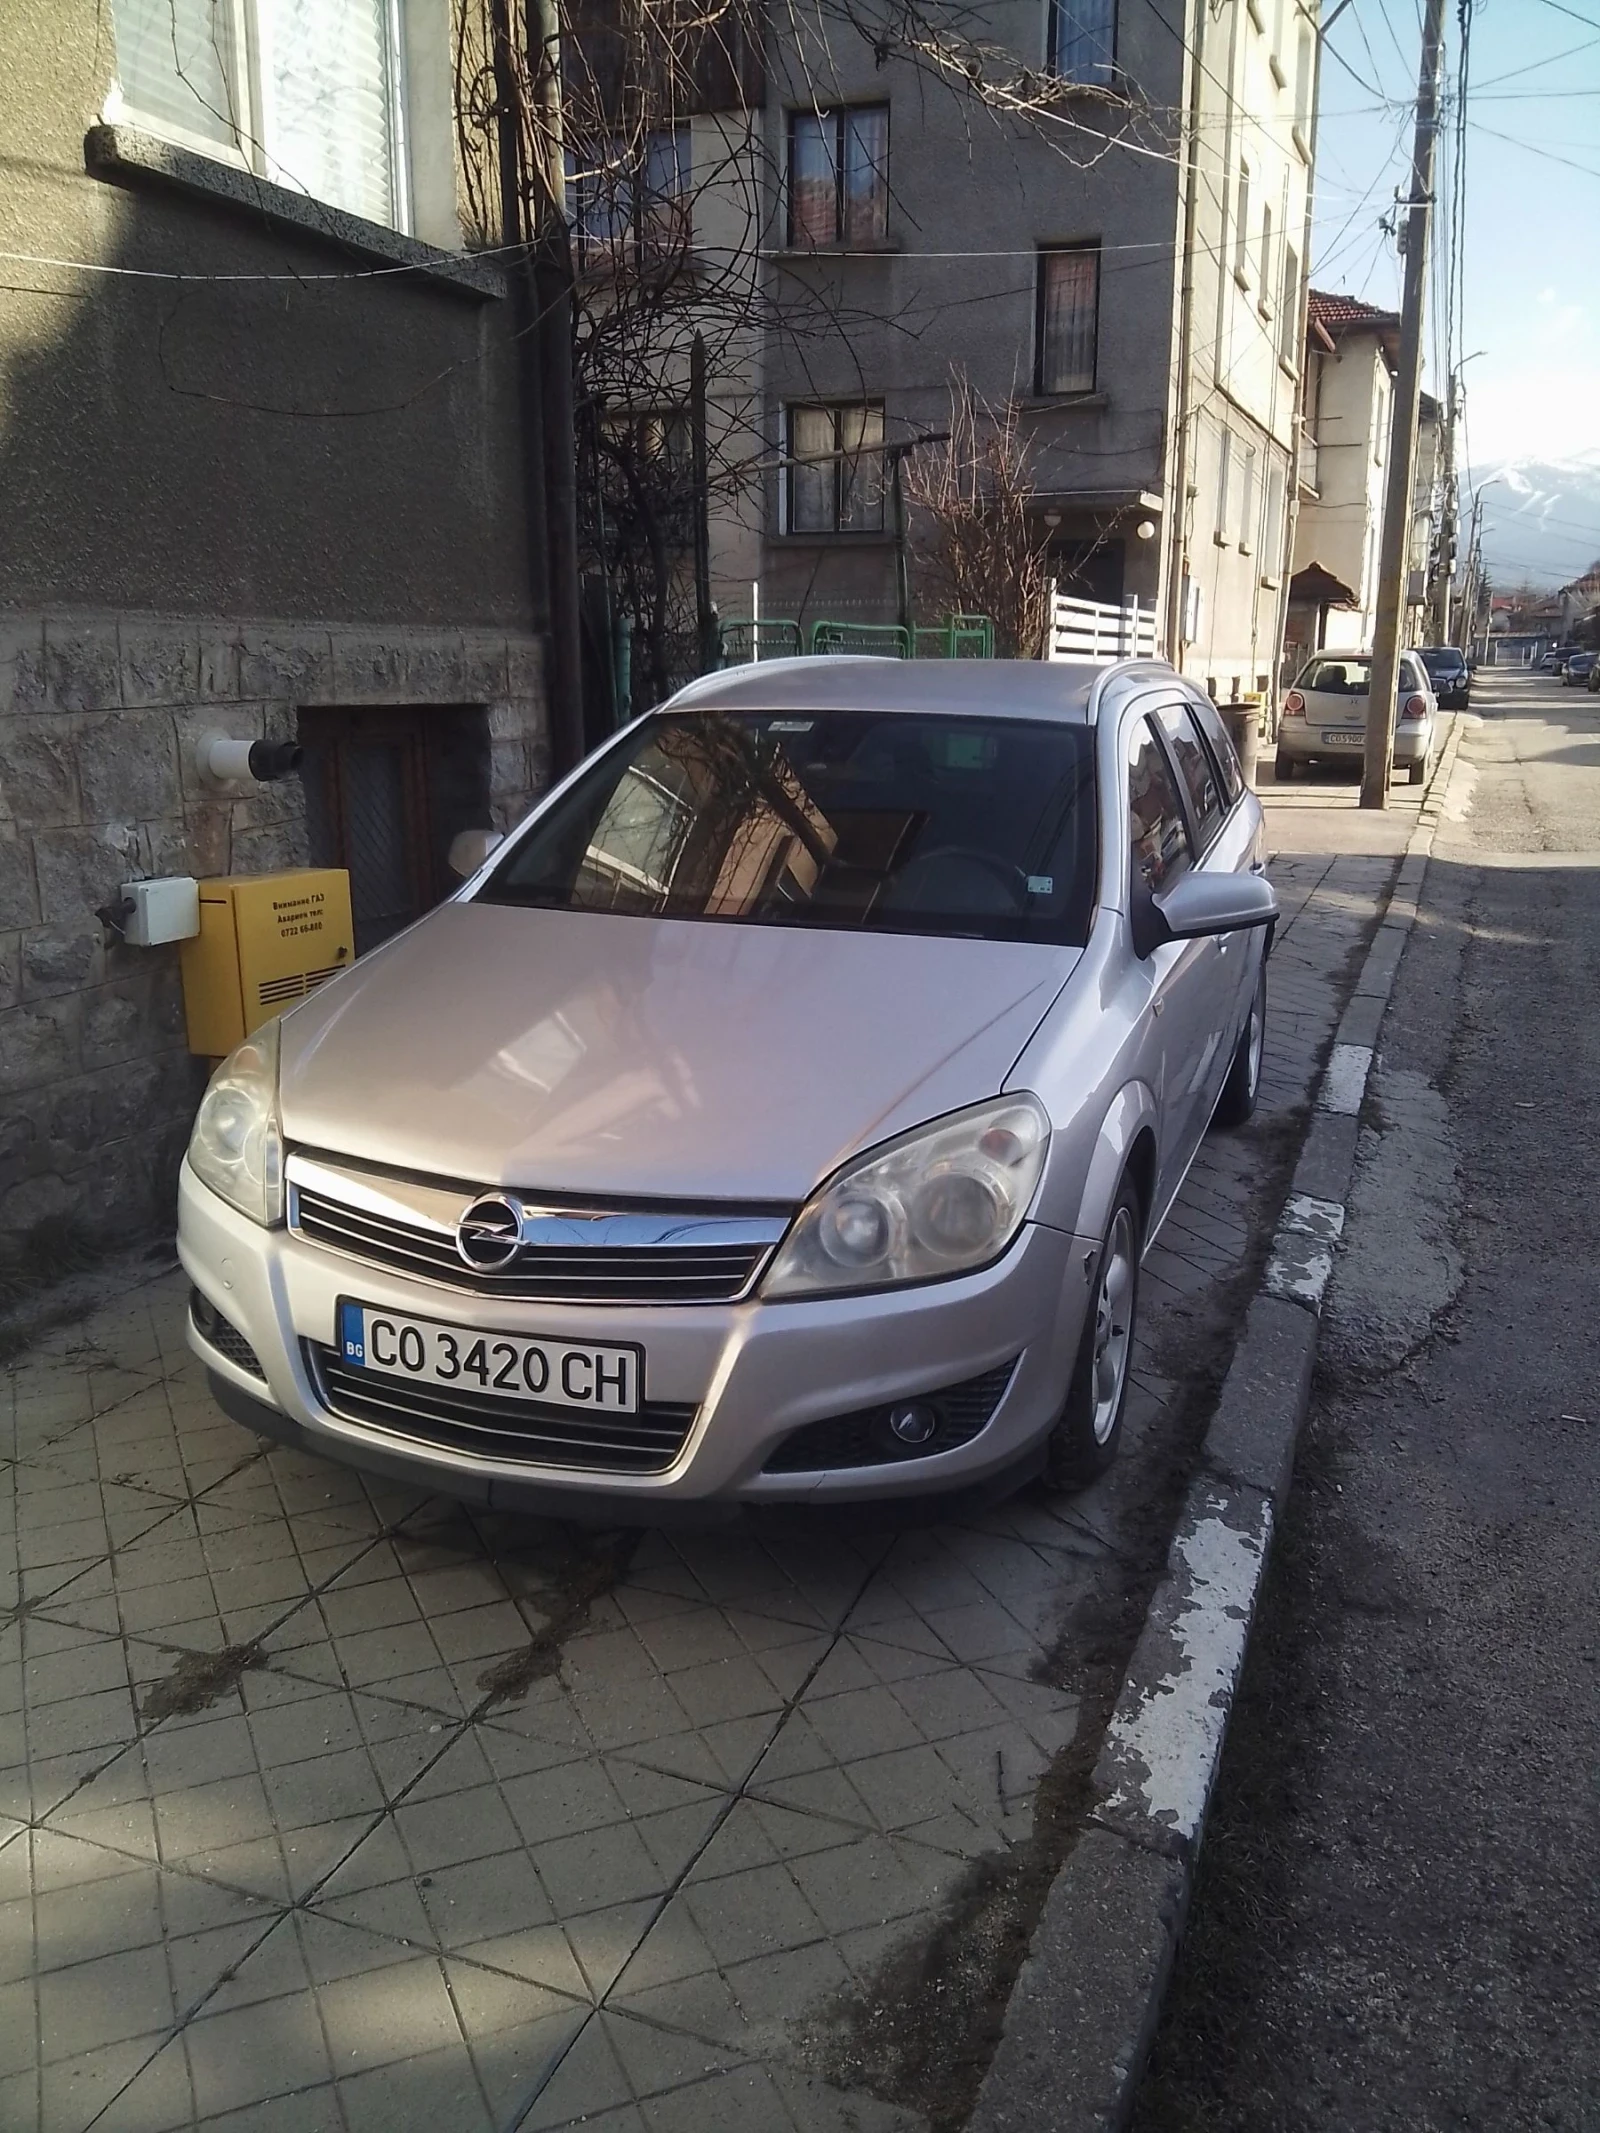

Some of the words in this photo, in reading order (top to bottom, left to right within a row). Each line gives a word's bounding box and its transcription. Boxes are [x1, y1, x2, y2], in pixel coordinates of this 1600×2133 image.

[272, 898, 310, 910] Внимание
[311, 893, 325, 903] ГАЗ
[277, 912, 308, 924] Авариен
[280, 926, 298, 937] 0722
[346, 1341, 363, 1357] BG
[371, 1319, 425, 1372] CO
[435, 1333, 549, 1393] 3420
[561, 1352, 626, 1405] CH
